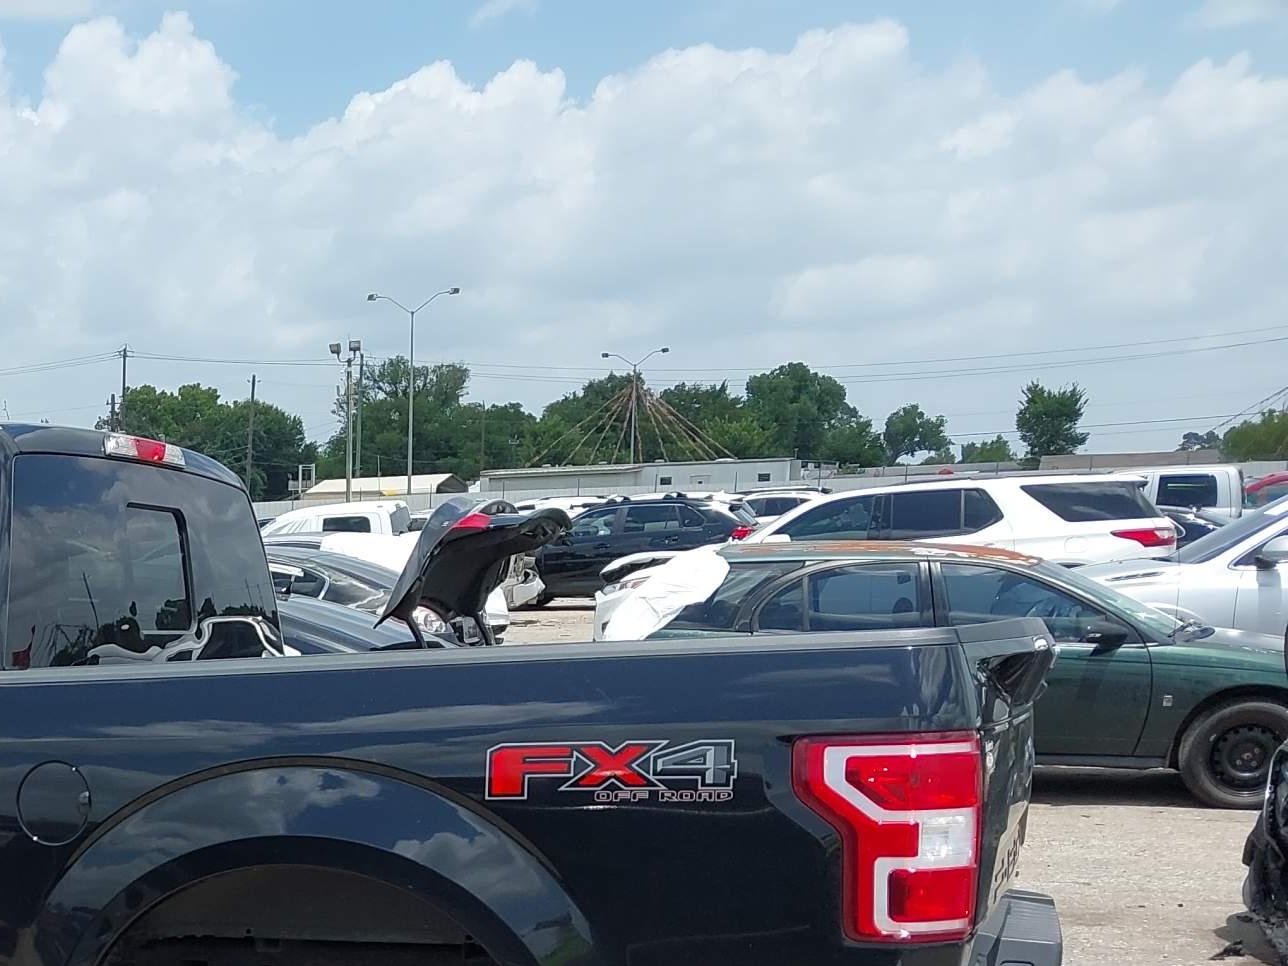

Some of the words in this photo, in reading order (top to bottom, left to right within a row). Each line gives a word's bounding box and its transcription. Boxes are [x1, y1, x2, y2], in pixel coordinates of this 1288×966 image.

[485, 739, 738, 800] FX4
[594, 790, 649, 802] OFF
[658, 790, 734, 802] ROAD
